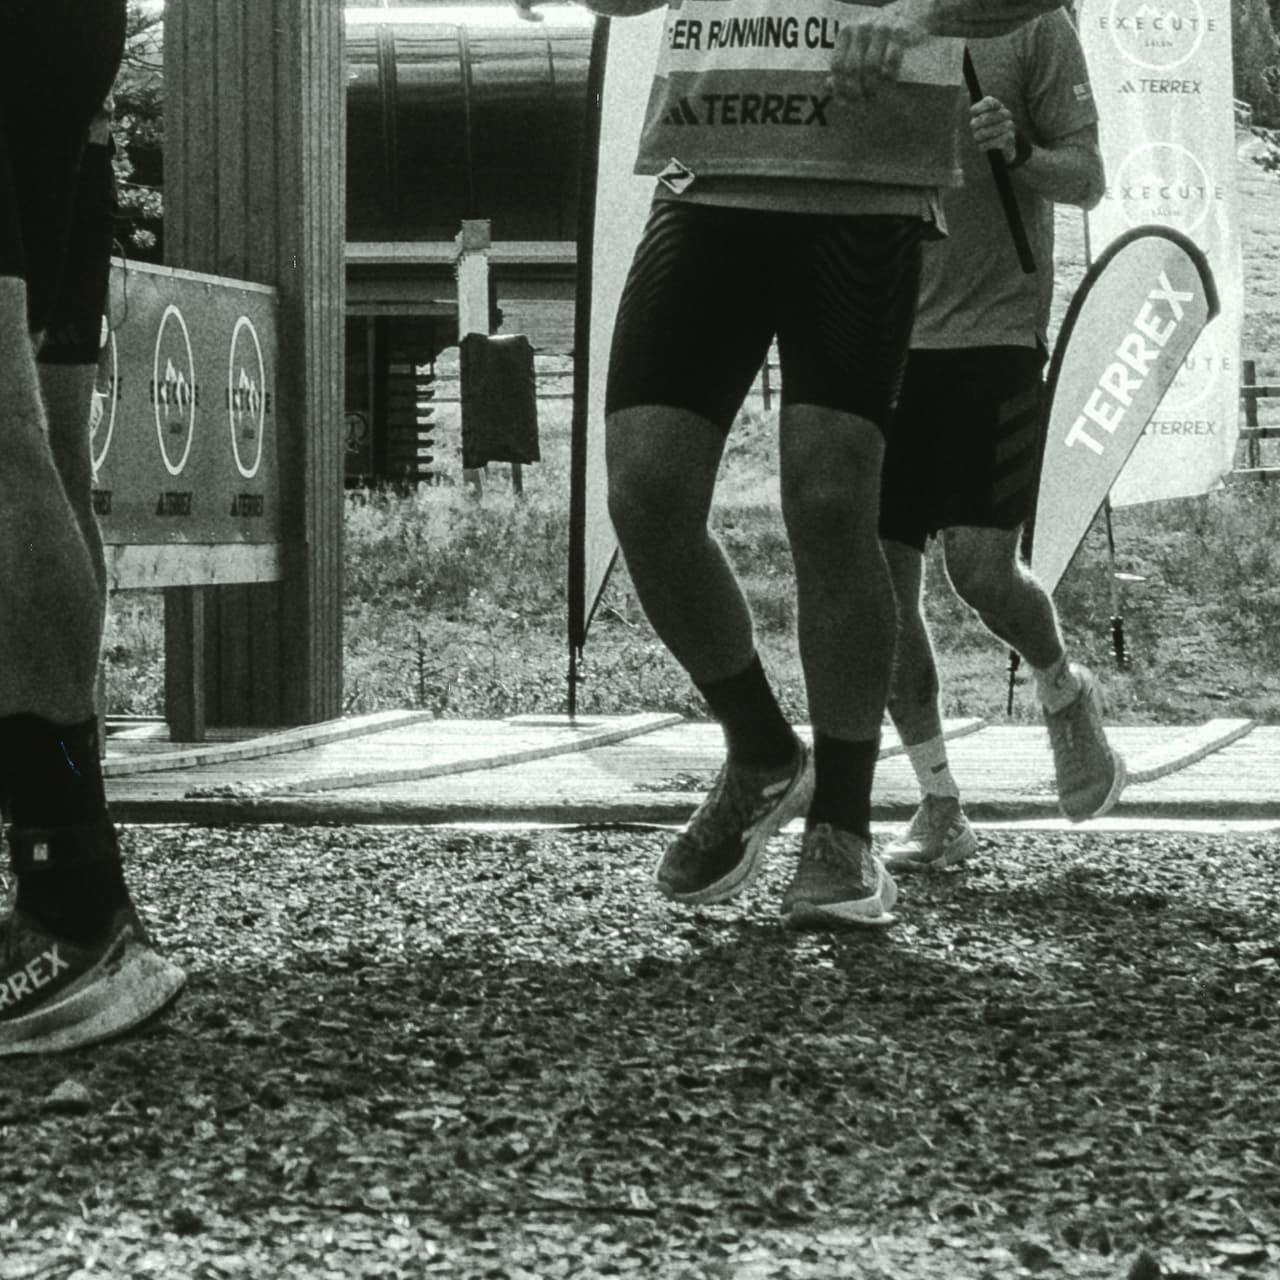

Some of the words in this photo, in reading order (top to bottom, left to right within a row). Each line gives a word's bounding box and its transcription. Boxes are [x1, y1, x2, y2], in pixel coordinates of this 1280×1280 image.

[706, 16, 799, 51] RUNNING
[1099, 16, 1217, 32] EXECUTE
[1138, 78, 1202, 95] TERREX
[701, 92, 834, 126] TERREX
[1064, 271, 1195, 456] TERREX
[1150, 421, 1216, 435] TERREX
